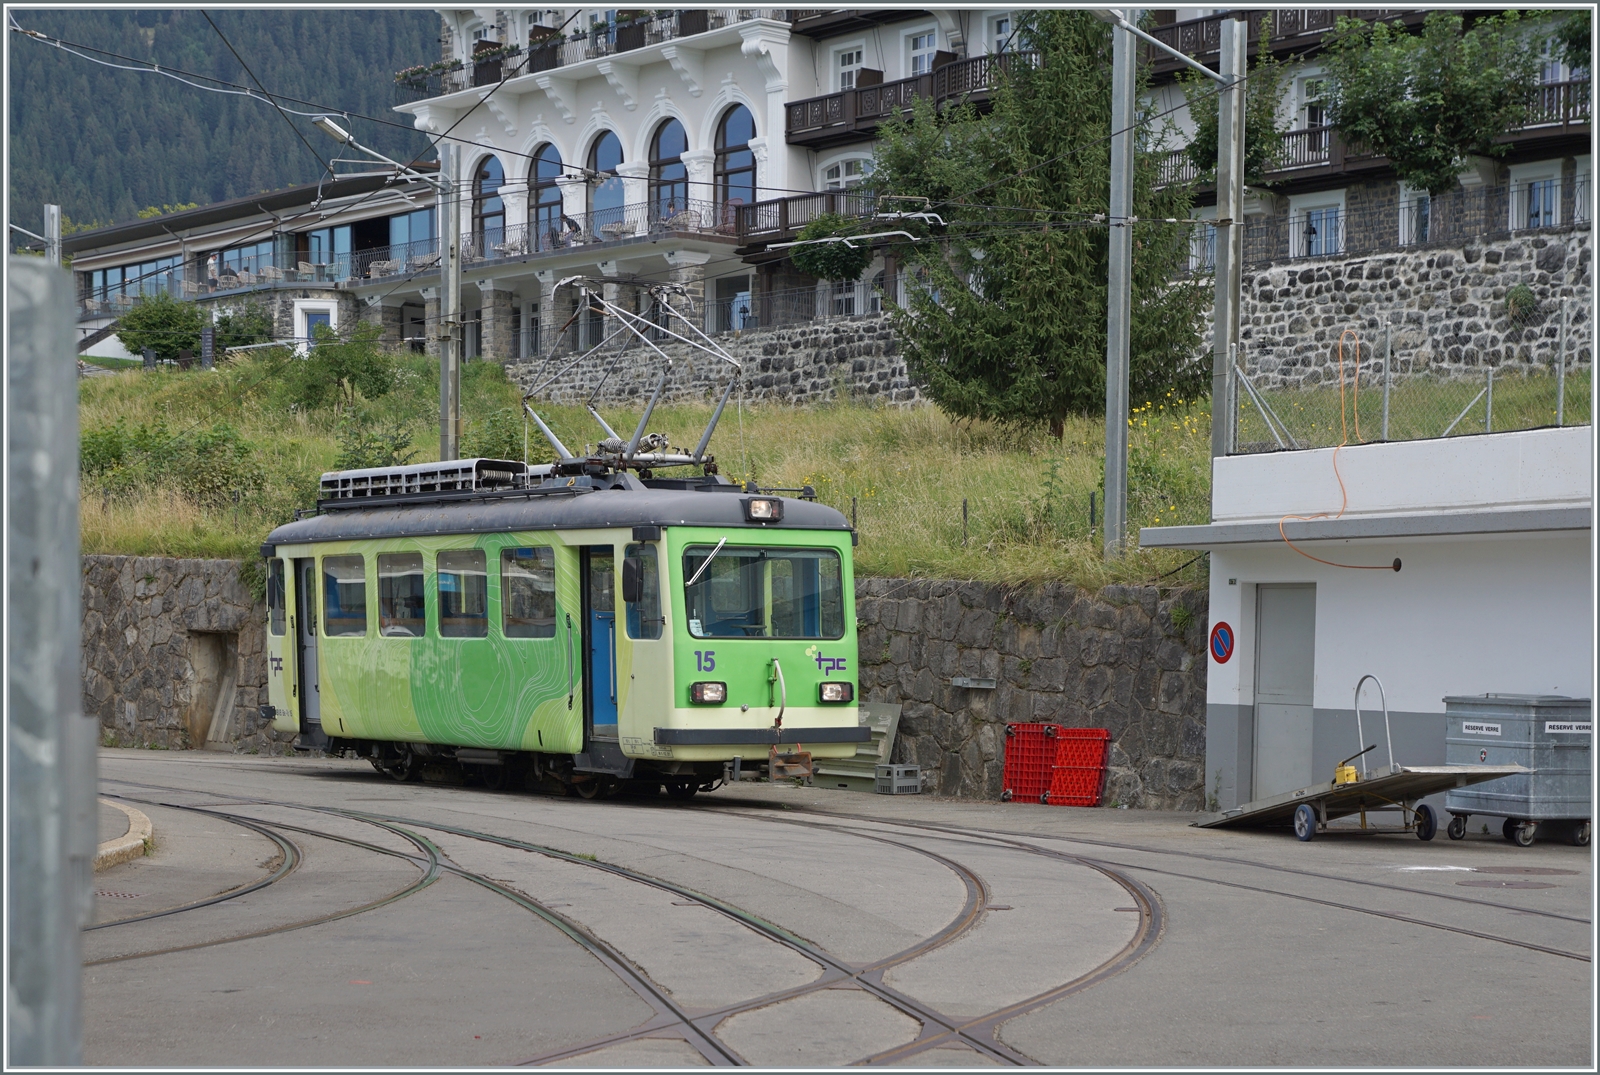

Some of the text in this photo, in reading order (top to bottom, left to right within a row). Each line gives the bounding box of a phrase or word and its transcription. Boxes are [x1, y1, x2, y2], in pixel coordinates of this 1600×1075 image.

[270, 651, 283, 677] tpc
[694, 650, 716, 672] 15
[815, 651, 847, 677] tpc
